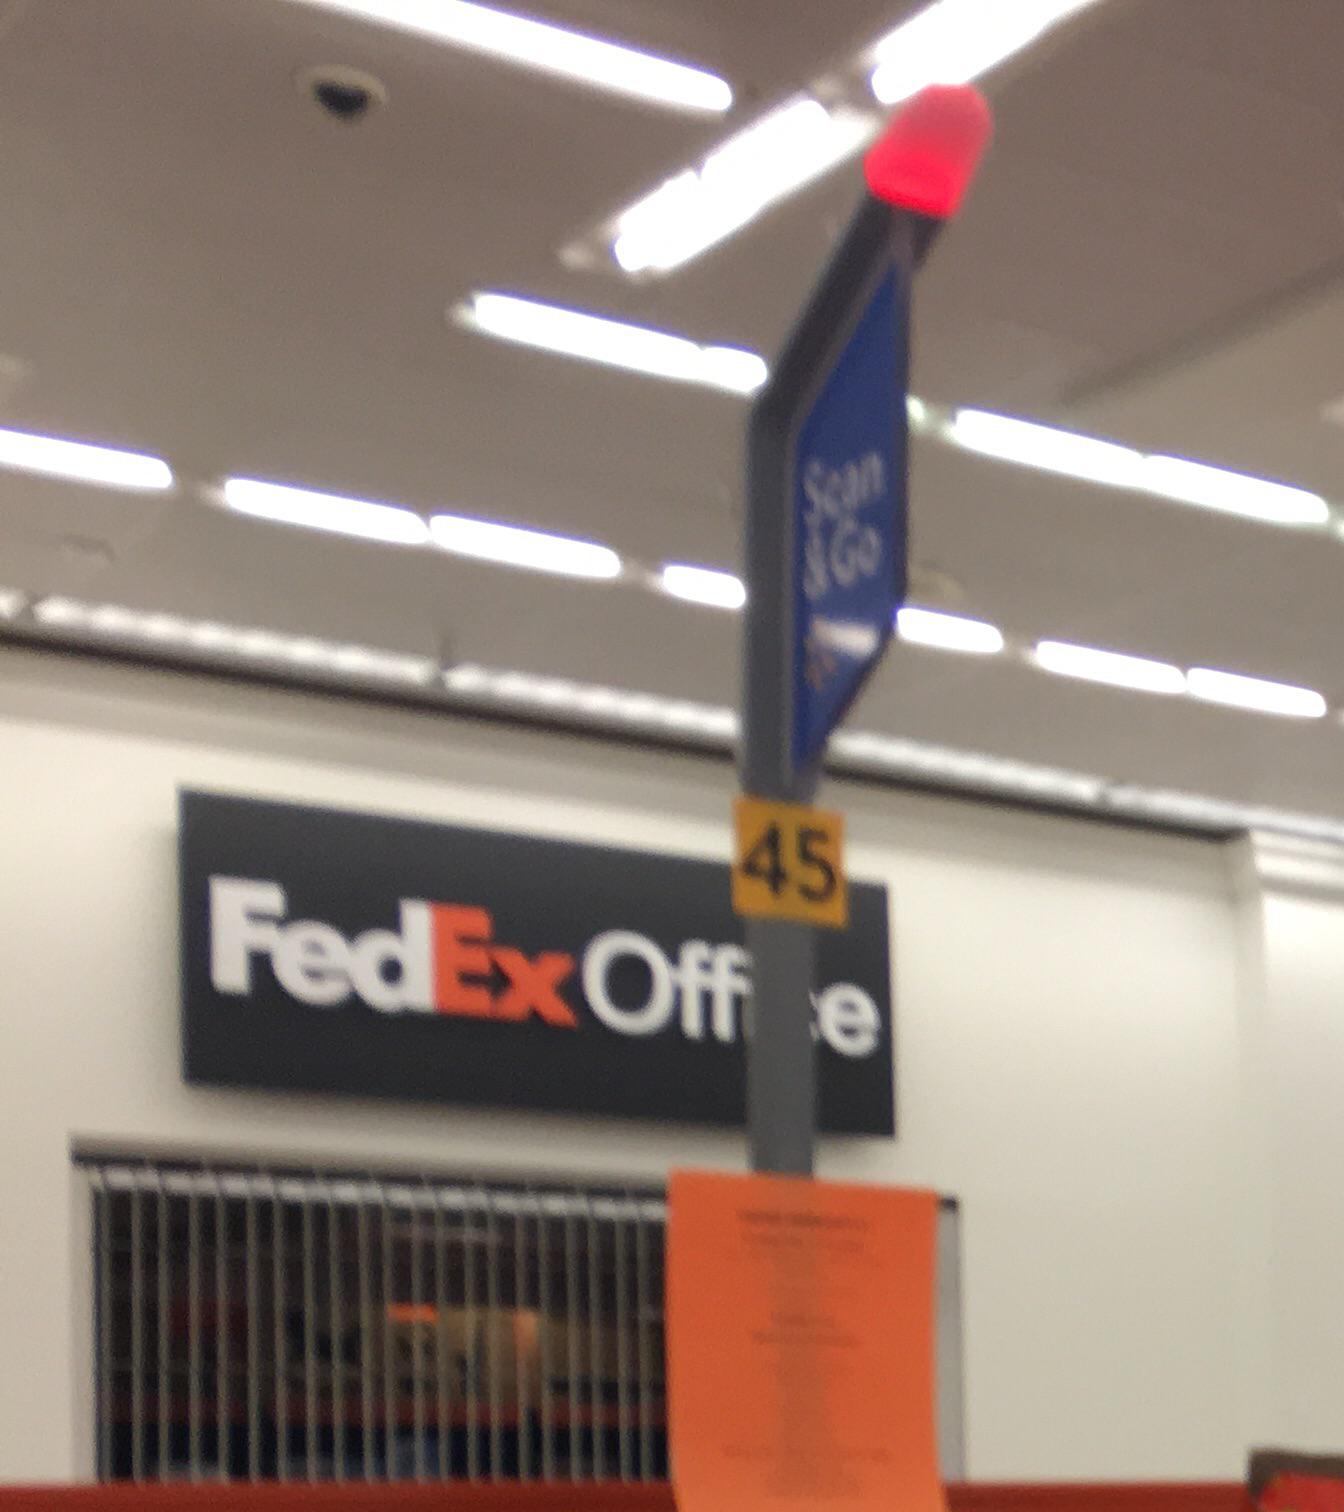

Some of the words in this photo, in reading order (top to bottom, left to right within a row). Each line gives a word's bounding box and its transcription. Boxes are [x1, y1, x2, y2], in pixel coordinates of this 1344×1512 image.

[742, 820, 838, 906] 45
[206, 873, 579, 1030] FedEx
[582, 928, 882, 1059] Offe
